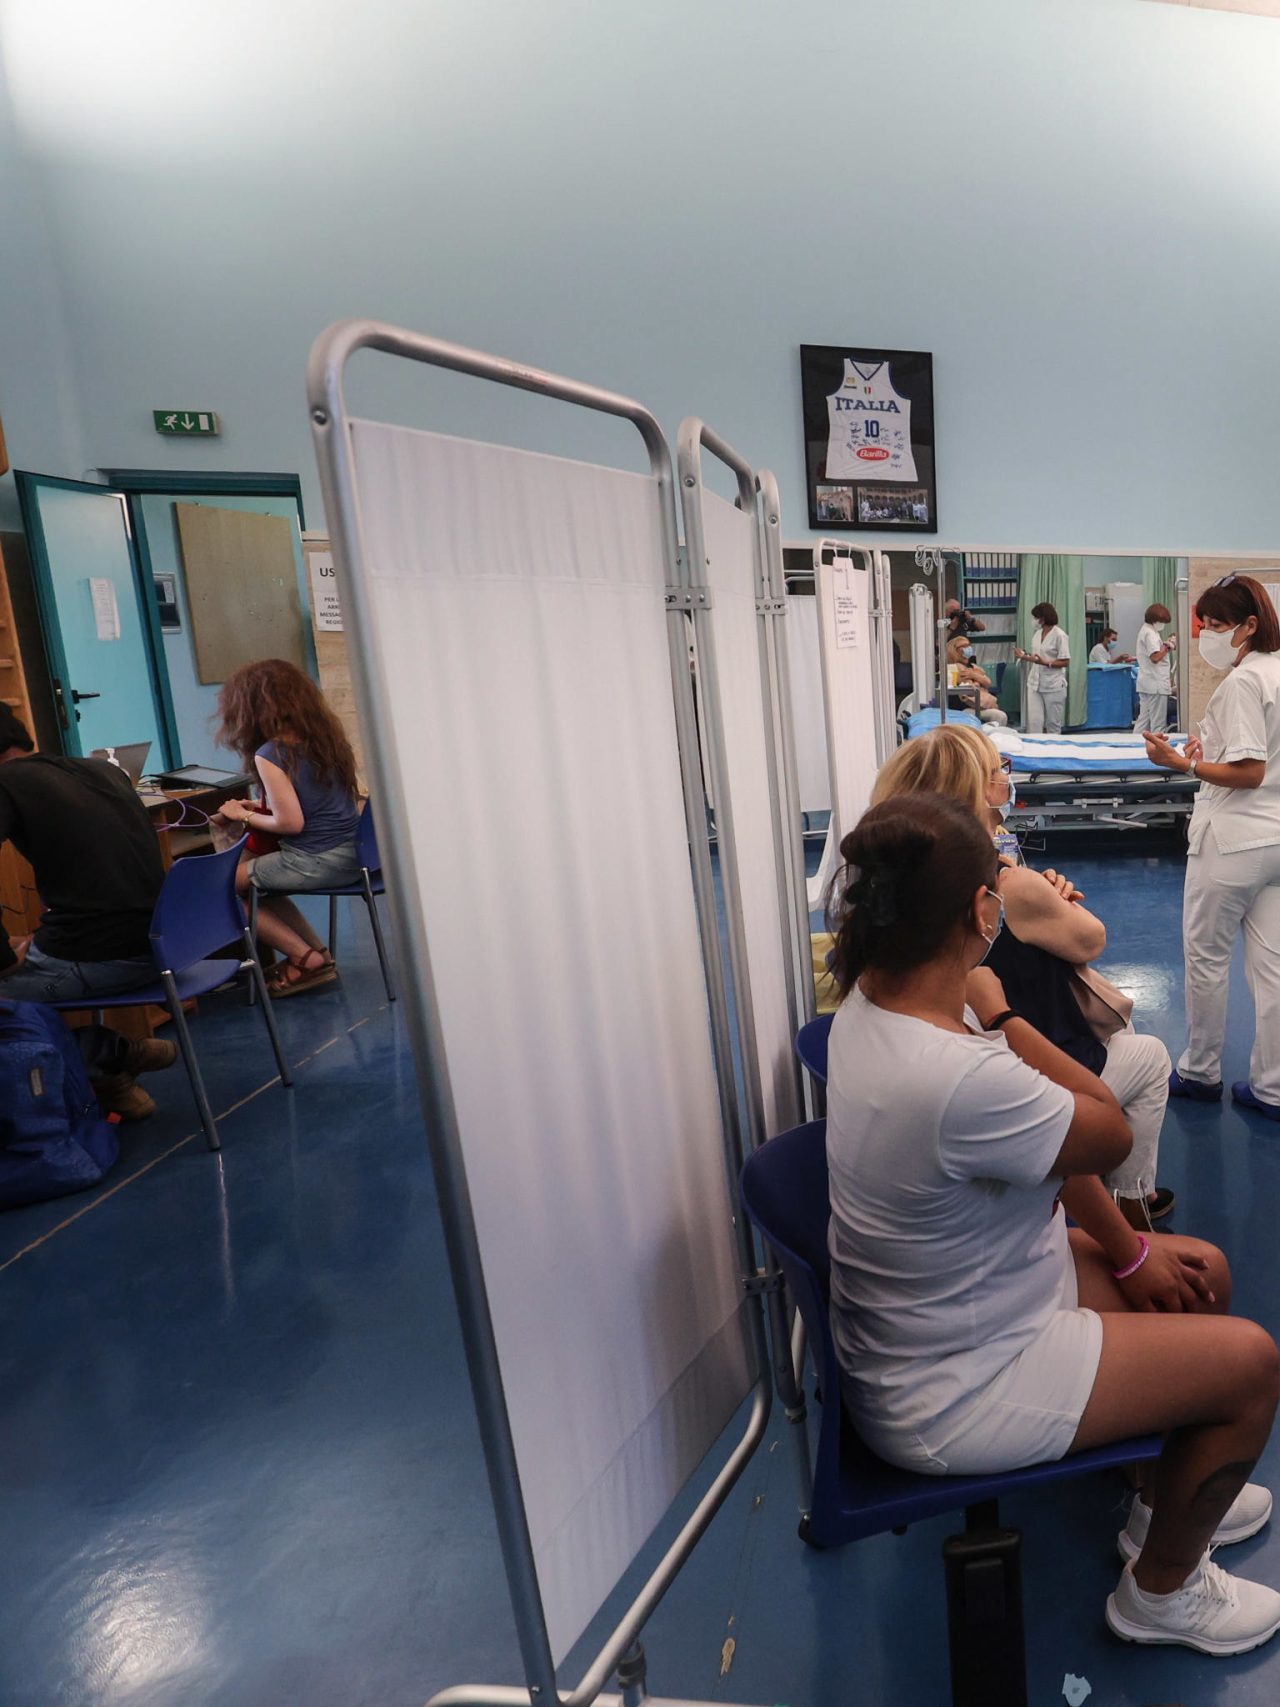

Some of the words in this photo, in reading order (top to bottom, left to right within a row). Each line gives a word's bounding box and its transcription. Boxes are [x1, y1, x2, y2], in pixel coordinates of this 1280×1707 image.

[835, 397, 900, 413] ITALIA
[864, 420, 879, 437] 10
[320, 568, 336, 577] US
